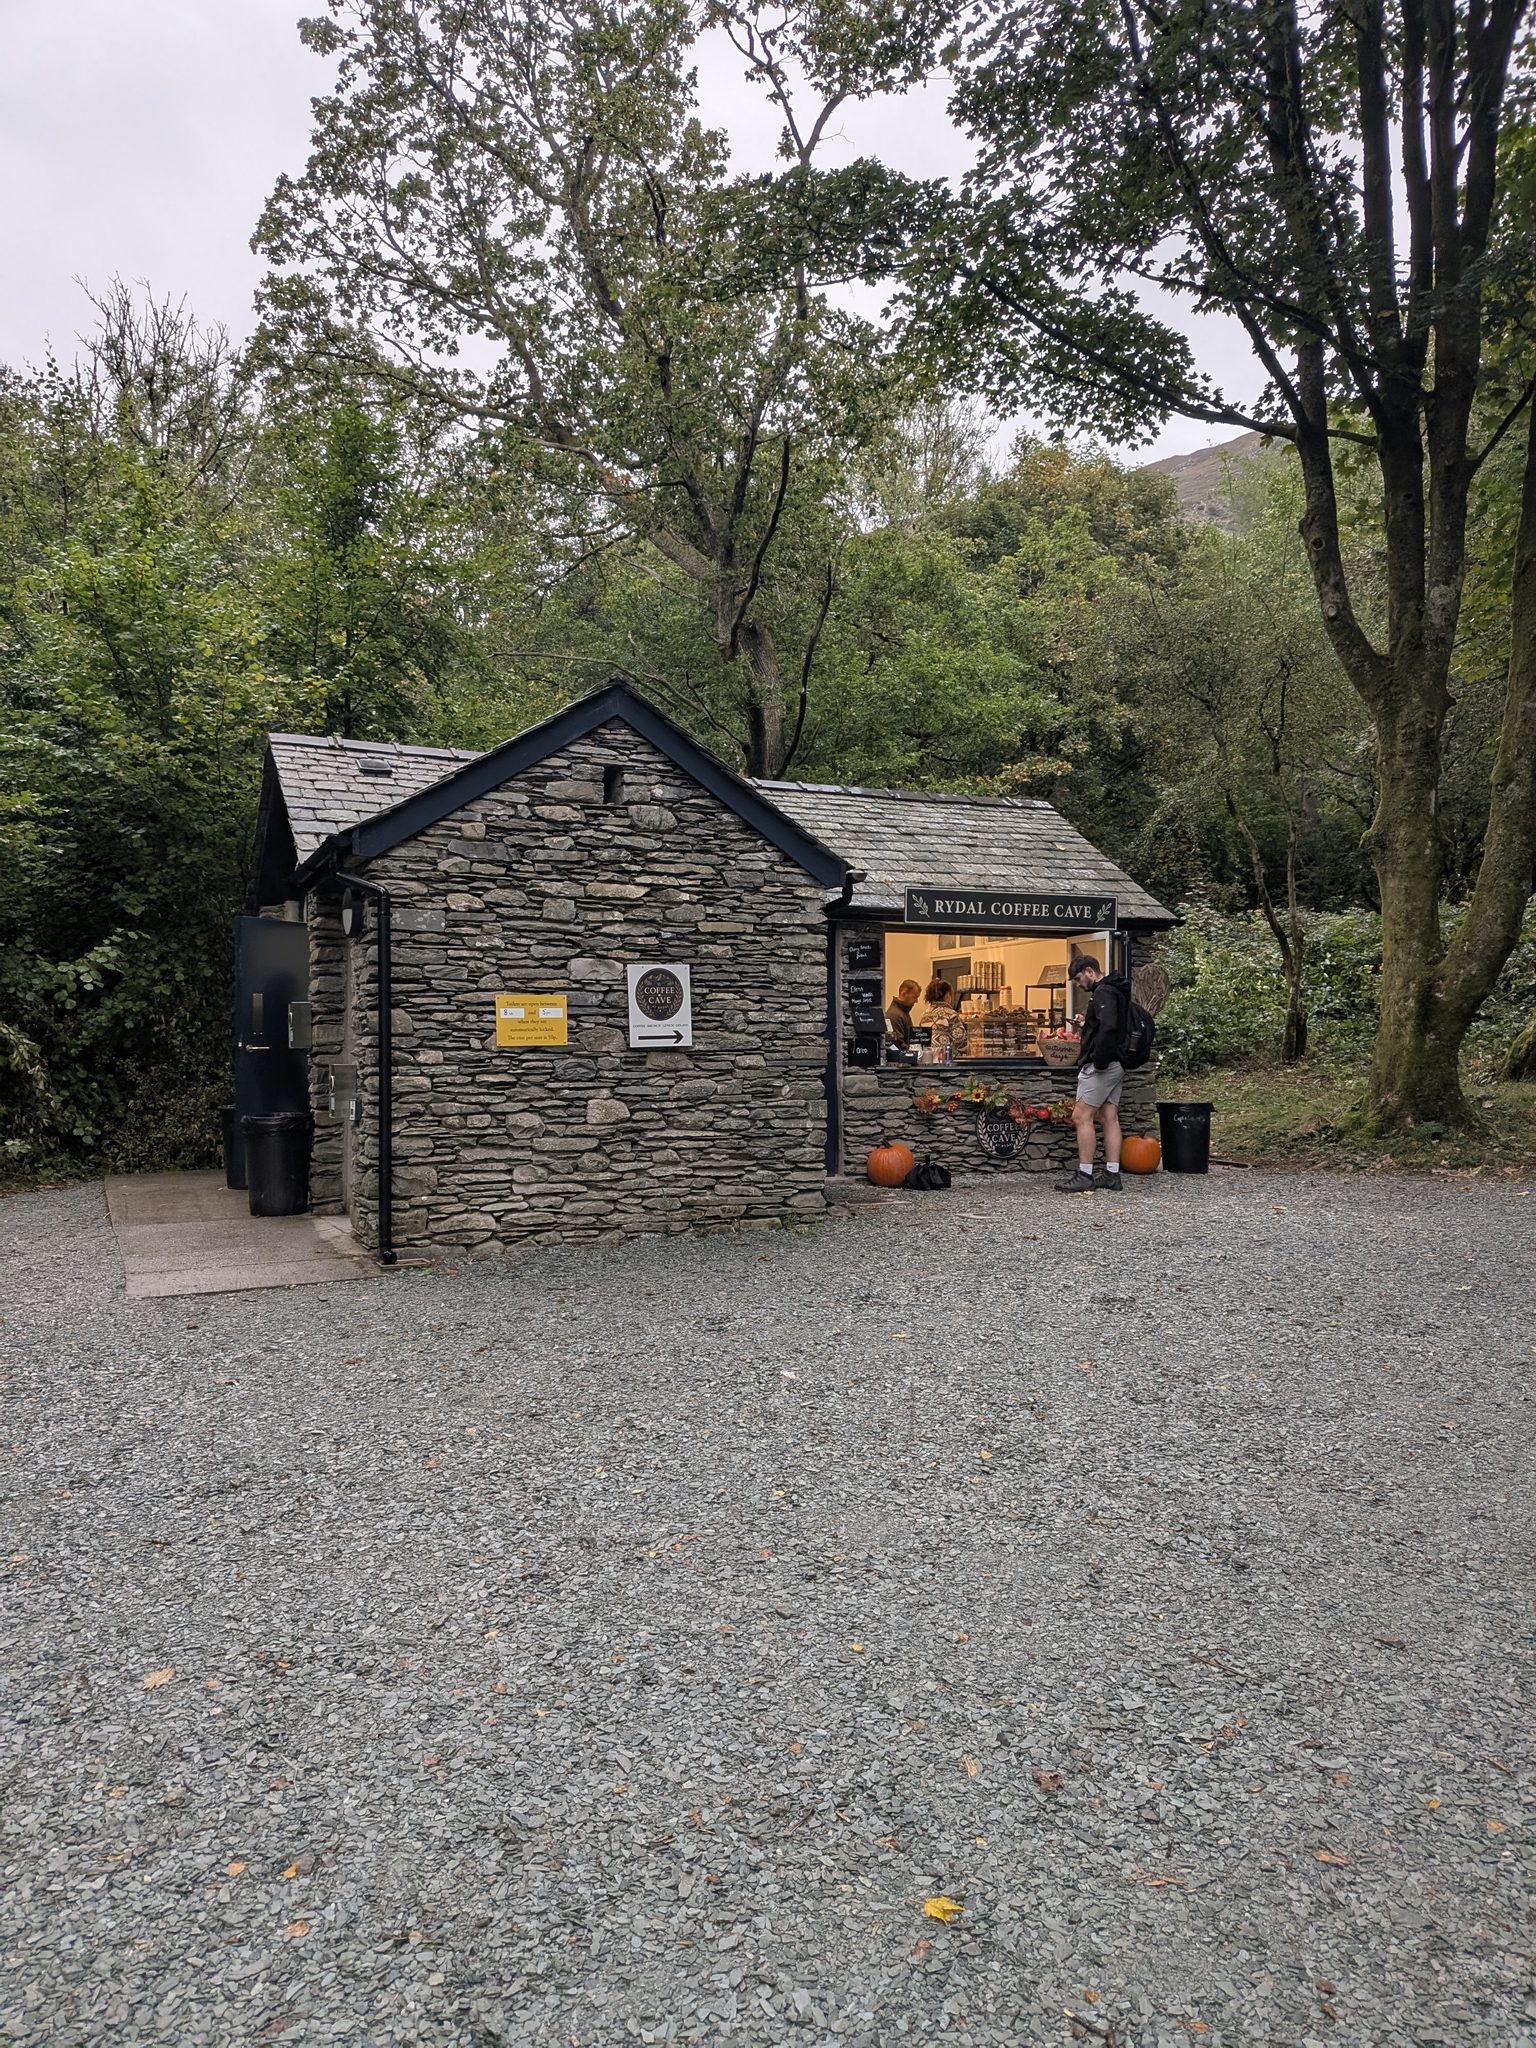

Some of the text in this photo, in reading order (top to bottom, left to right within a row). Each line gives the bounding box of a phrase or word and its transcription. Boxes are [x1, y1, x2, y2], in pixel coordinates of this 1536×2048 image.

[934, 899, 1092, 919] RYDAL COFFEE CAVE
[991, 1133, 1016, 1143] CAVE
